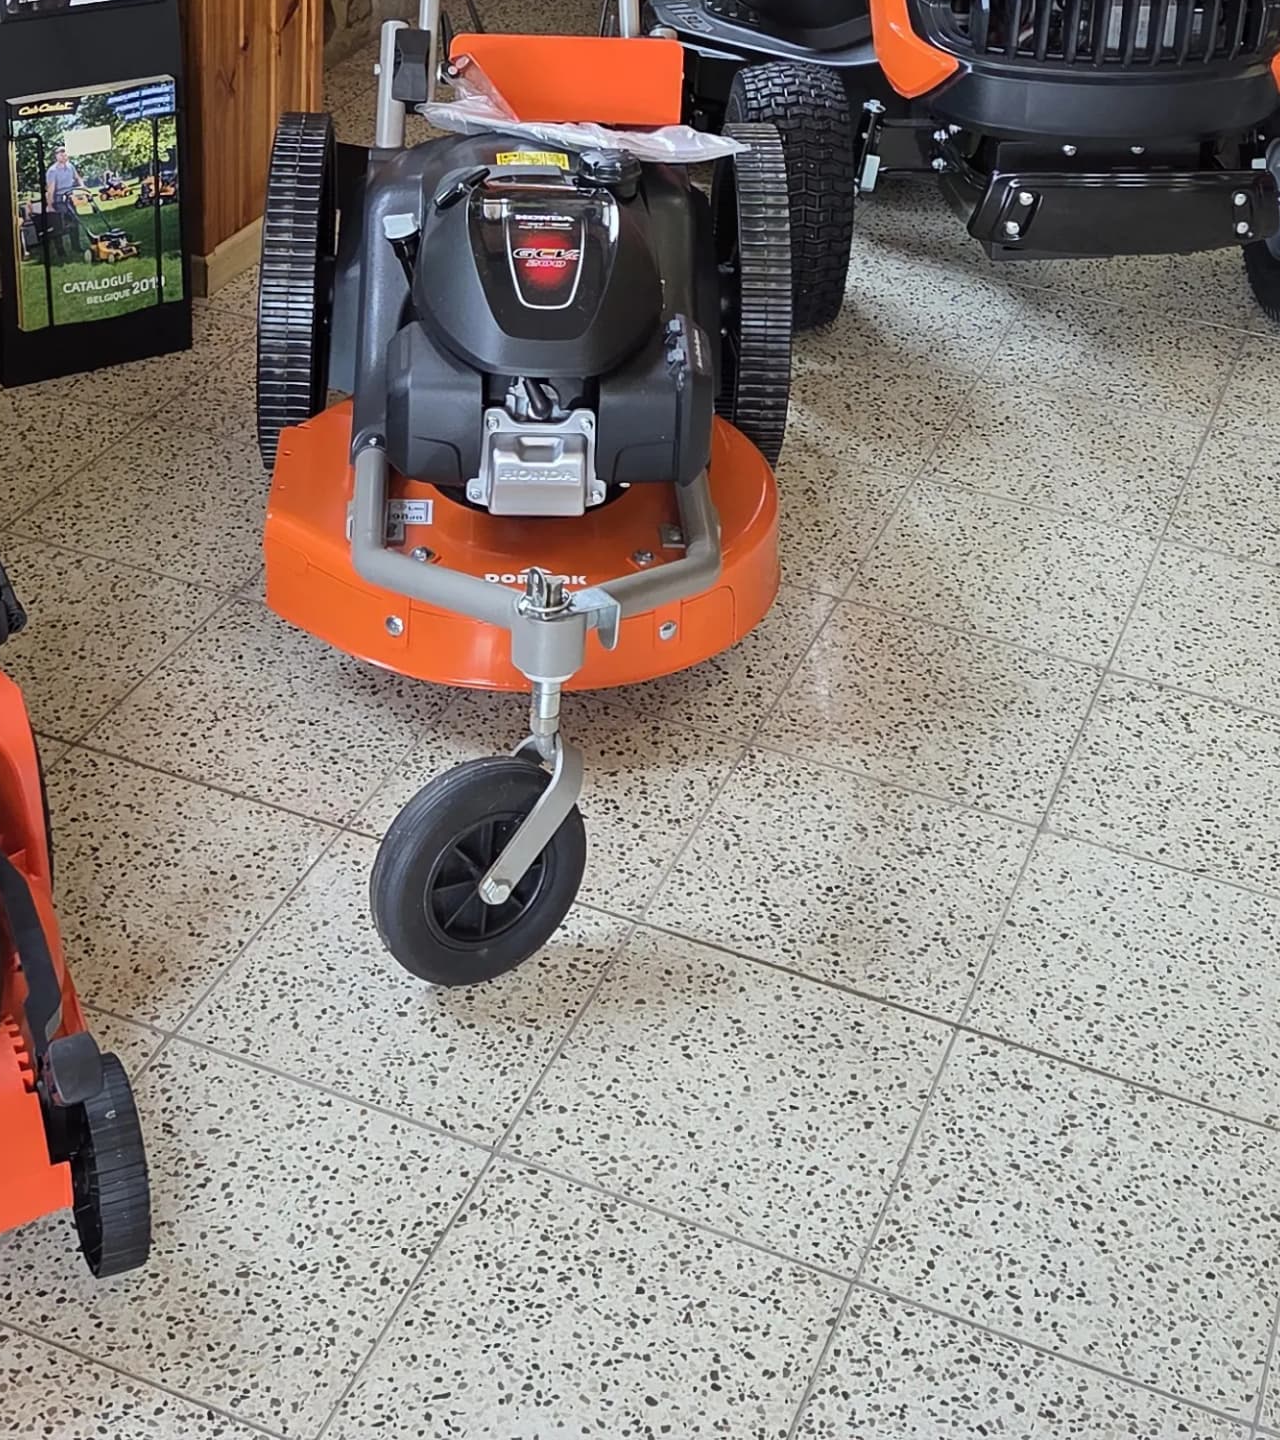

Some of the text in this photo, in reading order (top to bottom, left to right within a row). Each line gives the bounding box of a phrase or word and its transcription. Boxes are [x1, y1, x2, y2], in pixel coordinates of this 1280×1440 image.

[514, 213, 575, 222] HONDA
[63, 271, 134, 294] CATALOGUE
[86, 288, 131, 305] BELGIQUE
